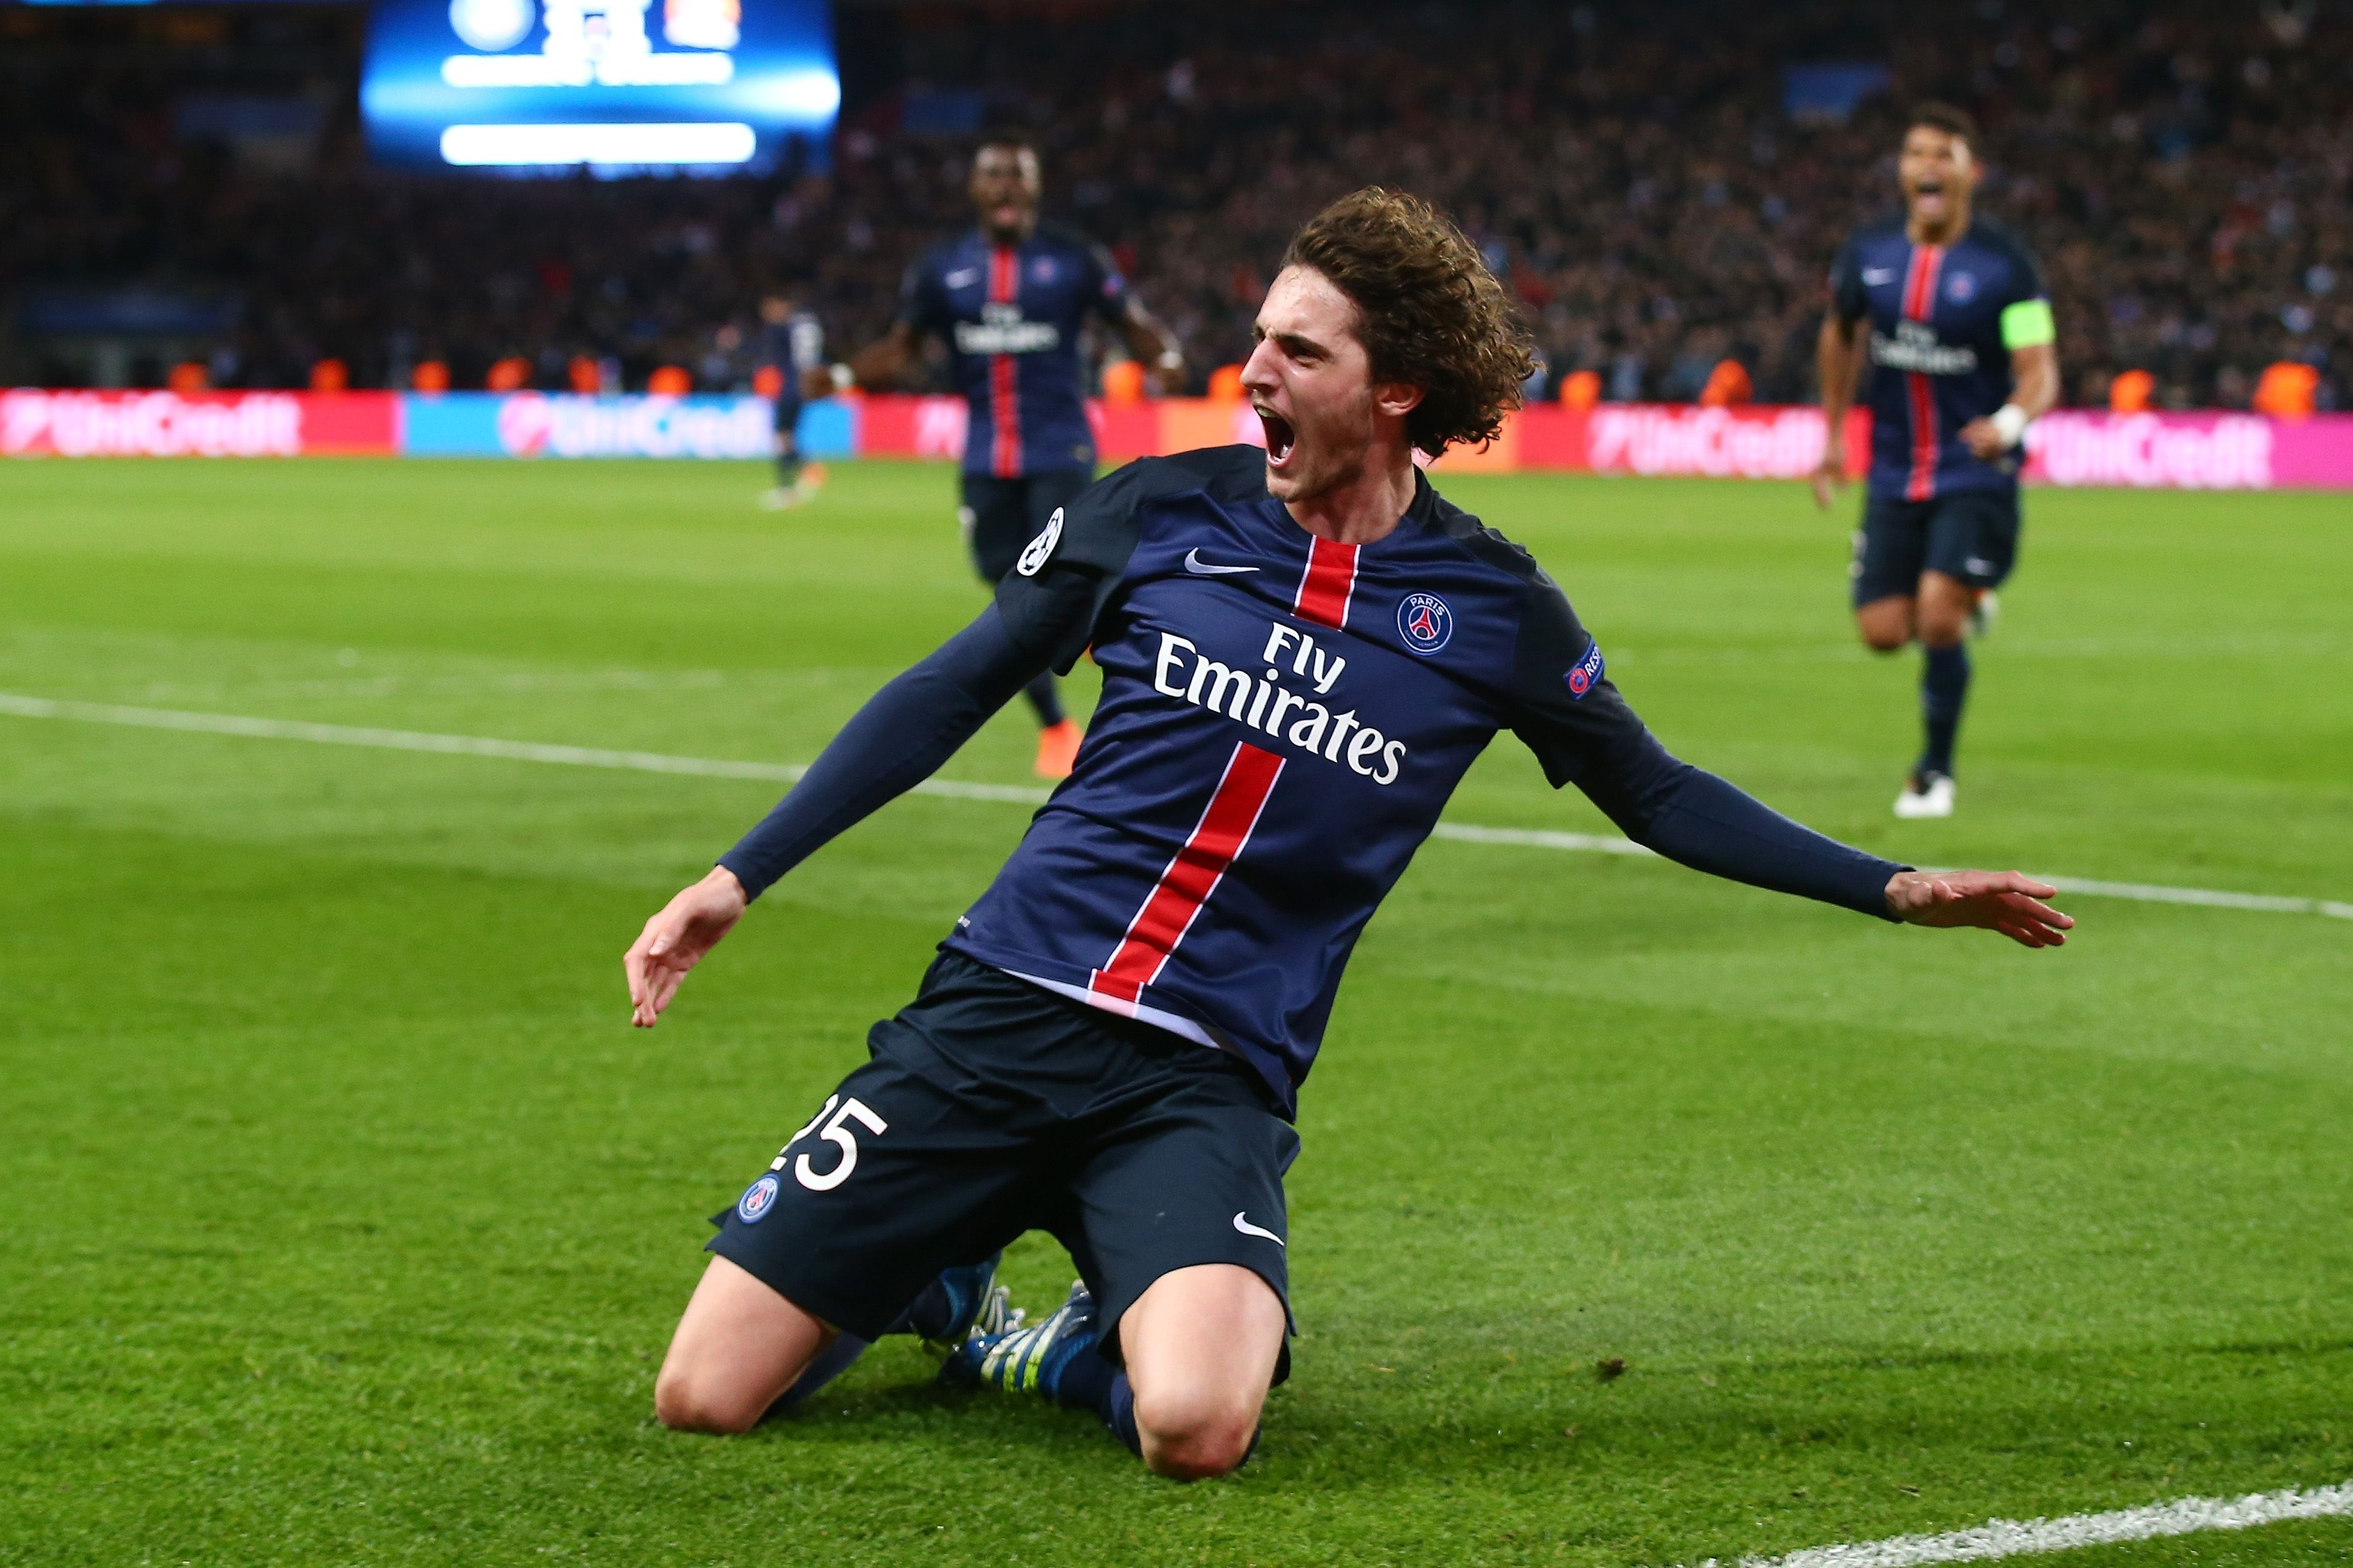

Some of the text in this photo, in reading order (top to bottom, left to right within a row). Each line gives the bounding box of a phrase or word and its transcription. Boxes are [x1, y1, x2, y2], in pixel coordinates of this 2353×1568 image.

[1410, 596, 1445, 616] PARIS
[1263, 622, 1346, 695] Fly
[1155, 632, 1407, 786] Emirates
